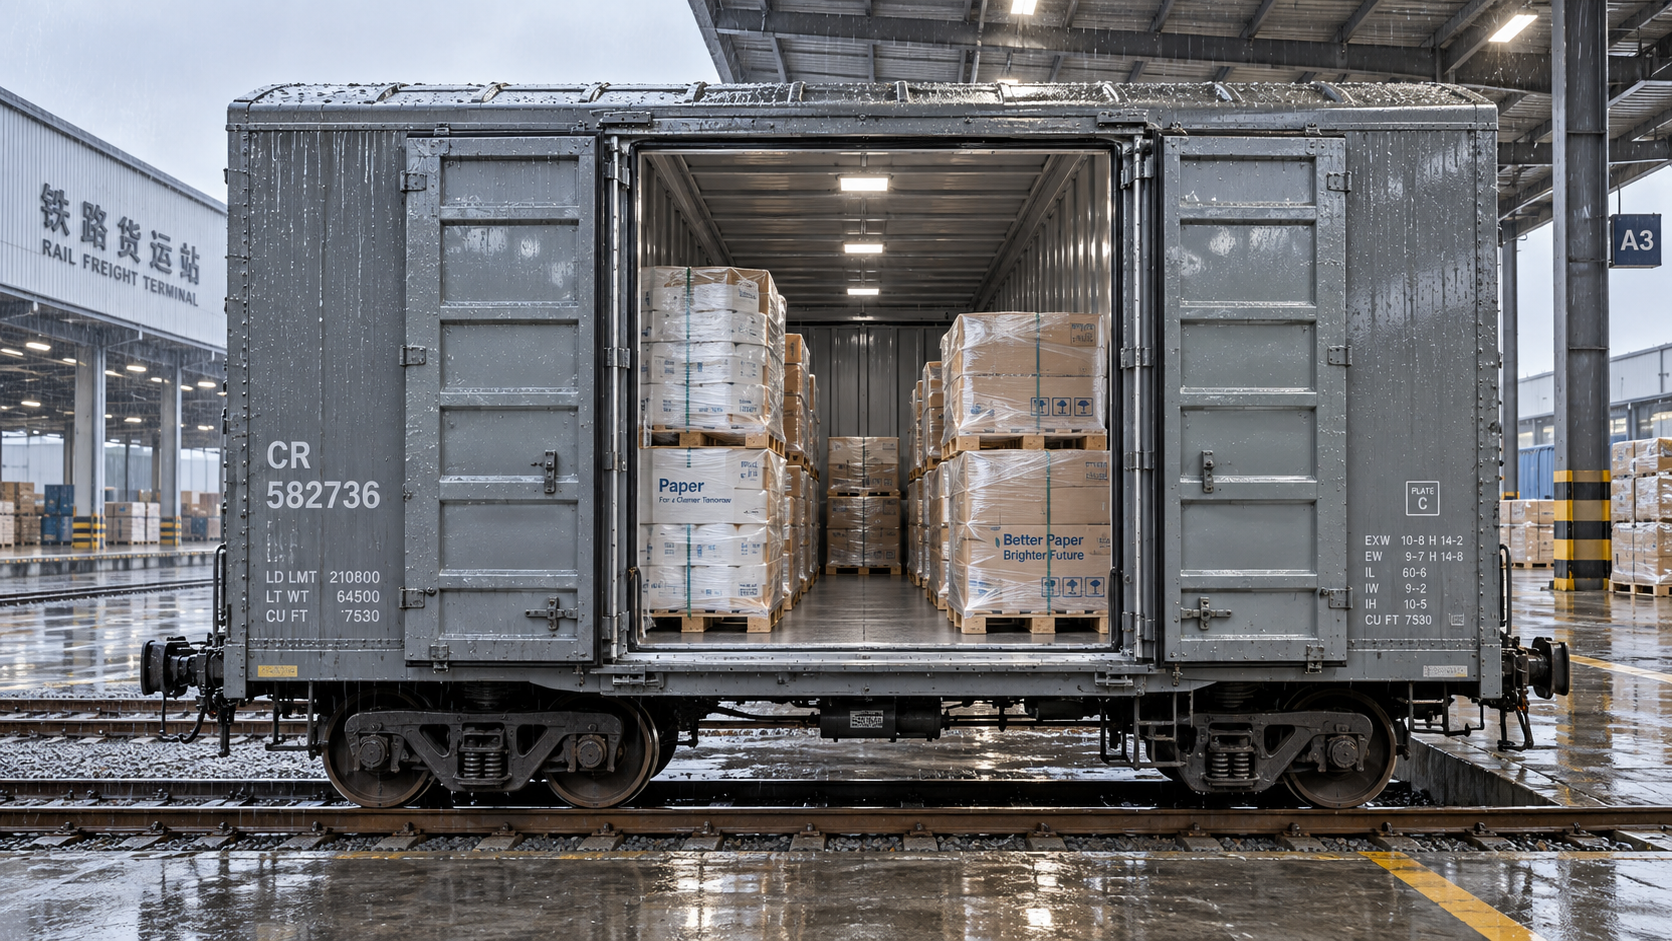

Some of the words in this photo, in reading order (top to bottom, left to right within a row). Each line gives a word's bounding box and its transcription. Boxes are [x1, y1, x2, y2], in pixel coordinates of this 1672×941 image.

[40, 182, 200, 285] 铁路货运站
[1620, 229, 1654, 251] A3
[42, 238, 76, 266] RAIL
[83, 253, 138, 287] FREIGHT
[143, 275, 198, 307] TERMINAL
[266, 440, 311, 469] CR
[659, 478, 705, 496] Paper
[1411, 487, 1435, 495] PLATE
[266, 480, 381, 509] 582736
[1418, 496, 1428, 510] C
[1003, 533, 1043, 546] Better
[1046, 533, 1084, 549] Paper
[1365, 535, 1391, 546] EXW
[1401, 535, 1425, 546] 10-8
[1429, 535, 1437, 546] H
[1441, 535, 1464, 546] 14-2
[1003, 549, 1047, 563] Brighter
[1049, 549, 1085, 560] Future
[1365, 551, 1383, 562] EW
[1405, 551, 1425, 562] 9-7
[1429, 551, 1437, 562] H
[1441, 551, 1464, 562] 14-8
[266, 570, 284, 583] LD
[288, 570, 317, 583] LMT
[329, 570, 380, 583] 210800
[1365, 567, 1375, 578] IL
[1402, 567, 1427, 578] 60-6
[1365, 583, 1379, 594] IW
[266, 590, 282, 603] LT
[287, 590, 310, 603] WT
[337, 590, 380, 603] 64500
[1365, 599, 1377, 609] IH
[1404, 599, 1427, 609] 10-5
[266, 609, 286, 622] CU
[291, 609, 308, 622] FT
[1365, 614, 1381, 625] CU
[1385, 614, 1399, 625] FT
